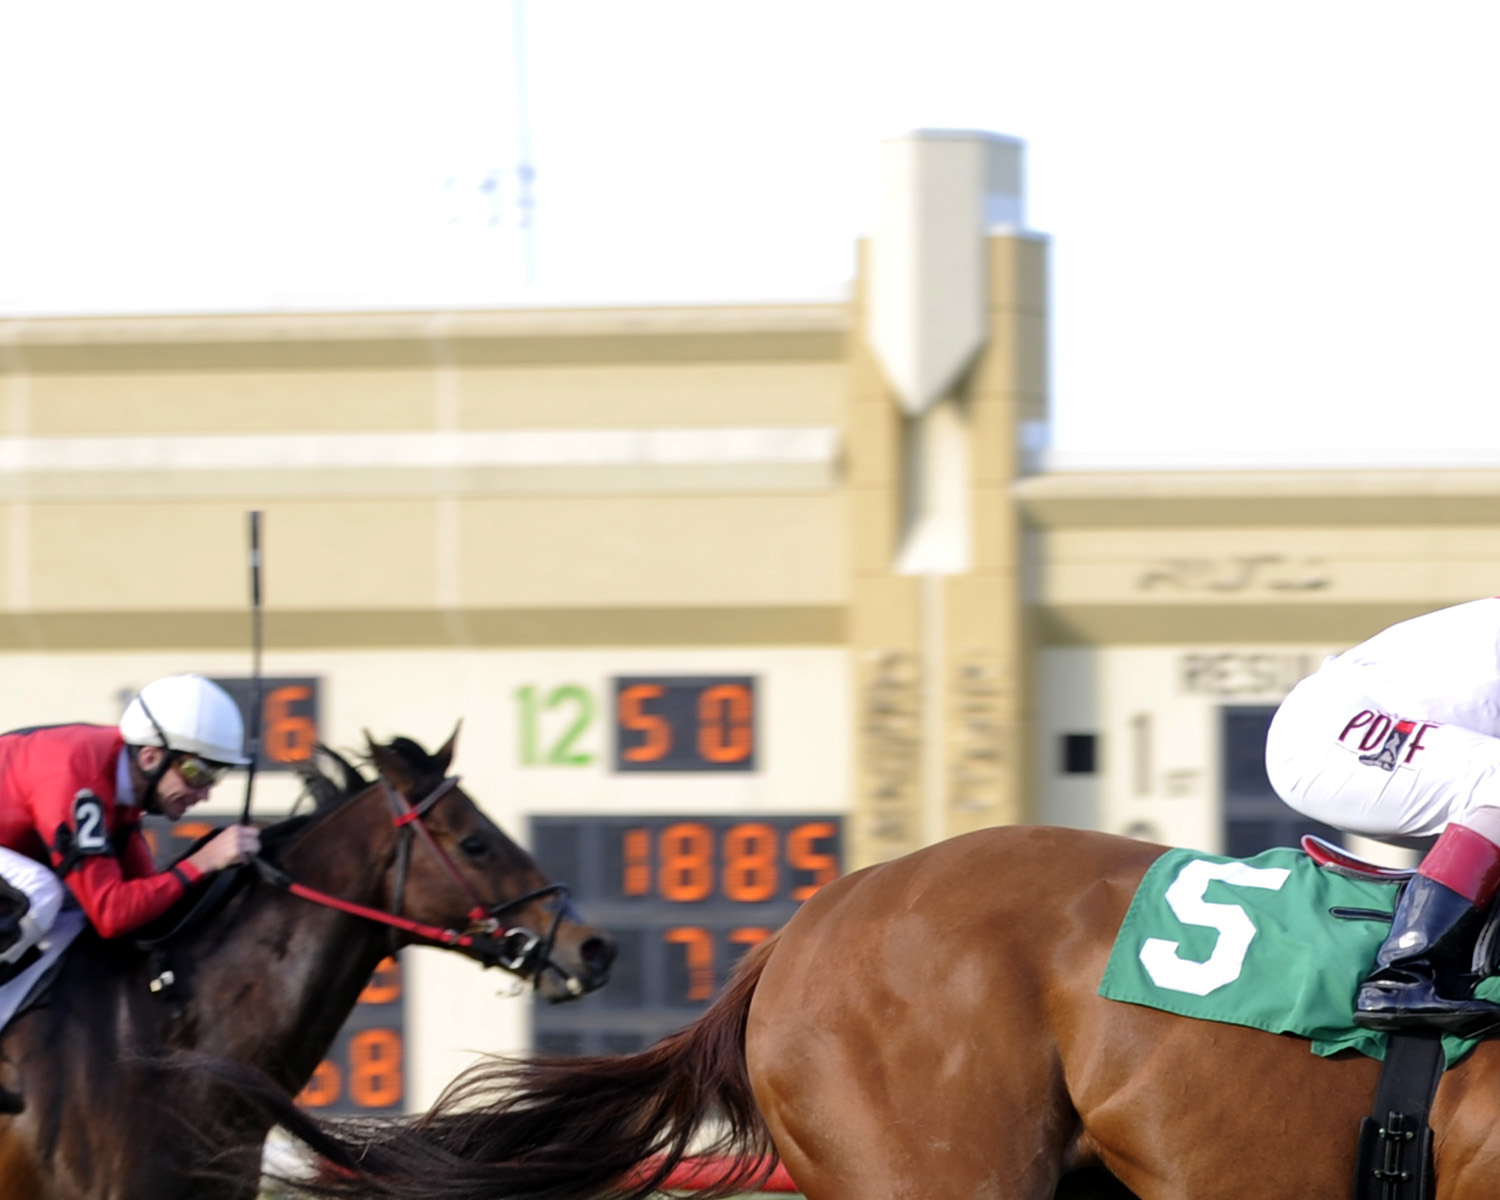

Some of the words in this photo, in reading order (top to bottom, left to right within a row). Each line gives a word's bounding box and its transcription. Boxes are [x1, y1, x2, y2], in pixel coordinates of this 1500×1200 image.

[265, 685, 317, 763] 6
[515, 684, 597, 767] 12
[75, 802, 105, 848] 2
[621, 820, 840, 902] 1885
[1138, 859, 1292, 997] 5
